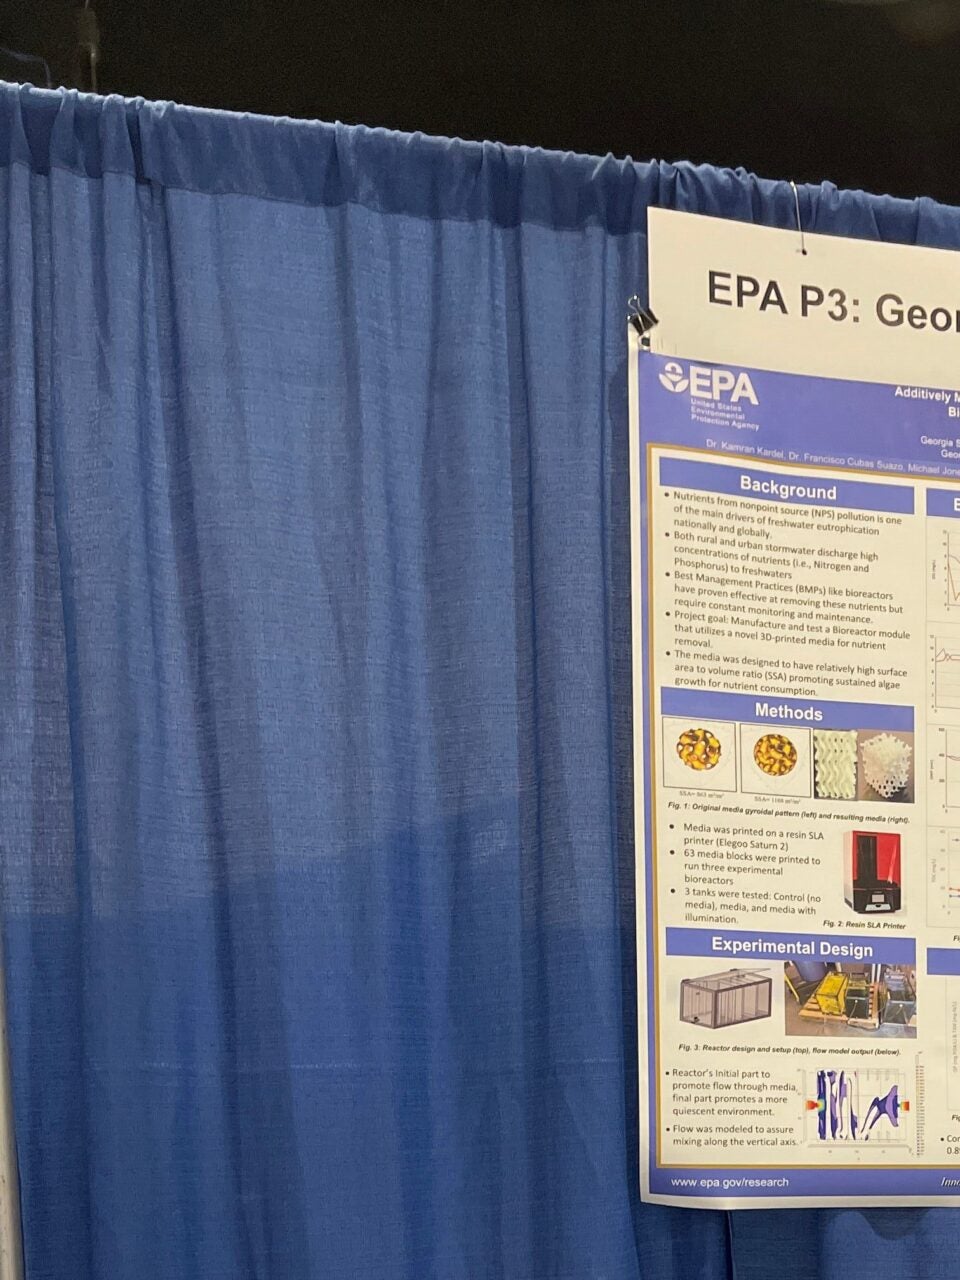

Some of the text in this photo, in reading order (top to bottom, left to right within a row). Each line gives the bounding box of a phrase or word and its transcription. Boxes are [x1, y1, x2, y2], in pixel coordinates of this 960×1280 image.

[709, 270, 788, 314] EPA
[801, 284, 859, 323] P3:
[690, 365, 759, 406] EPA
[894, 386, 951, 404] Additively
[920, 435, 953, 448] Georgia
[740, 475, 836, 500] Background
[673, 491, 715, 504] Nutrients
[717, 496, 738, 507] from
[739, 501, 778, 513] nonpoint
[780, 507, 809, 516] source
[811, 508, 835, 520] (NPS)
[837, 511, 875, 522] pollution
[877, 515, 883, 523] is
[673, 504, 879, 535] of the main drivers of freshwater eutrophication
[673, 519, 772, 540] nationally and globally.
[756, 702, 822, 721] Methods
[684, 823, 711, 832] Media
[732, 828, 763, 836] printed
[786, 831, 806, 839] resin
[808, 831, 824, 840] SLA
[684, 836, 788, 852] printer (Elegoo Saturn 2)
[712, 936, 872, 959] Experimental Design
[673, 1124, 693, 1133] Flow
[715, 1124, 753, 1133] modeled
[673, 1138, 702, 1147] mixing
[704, 1137, 728, 1147] along
[730, 1137, 744, 1145] the
[746, 1137, 778, 1146] vertical
[671, 1177, 789, 1189] www.epa.gov/research
